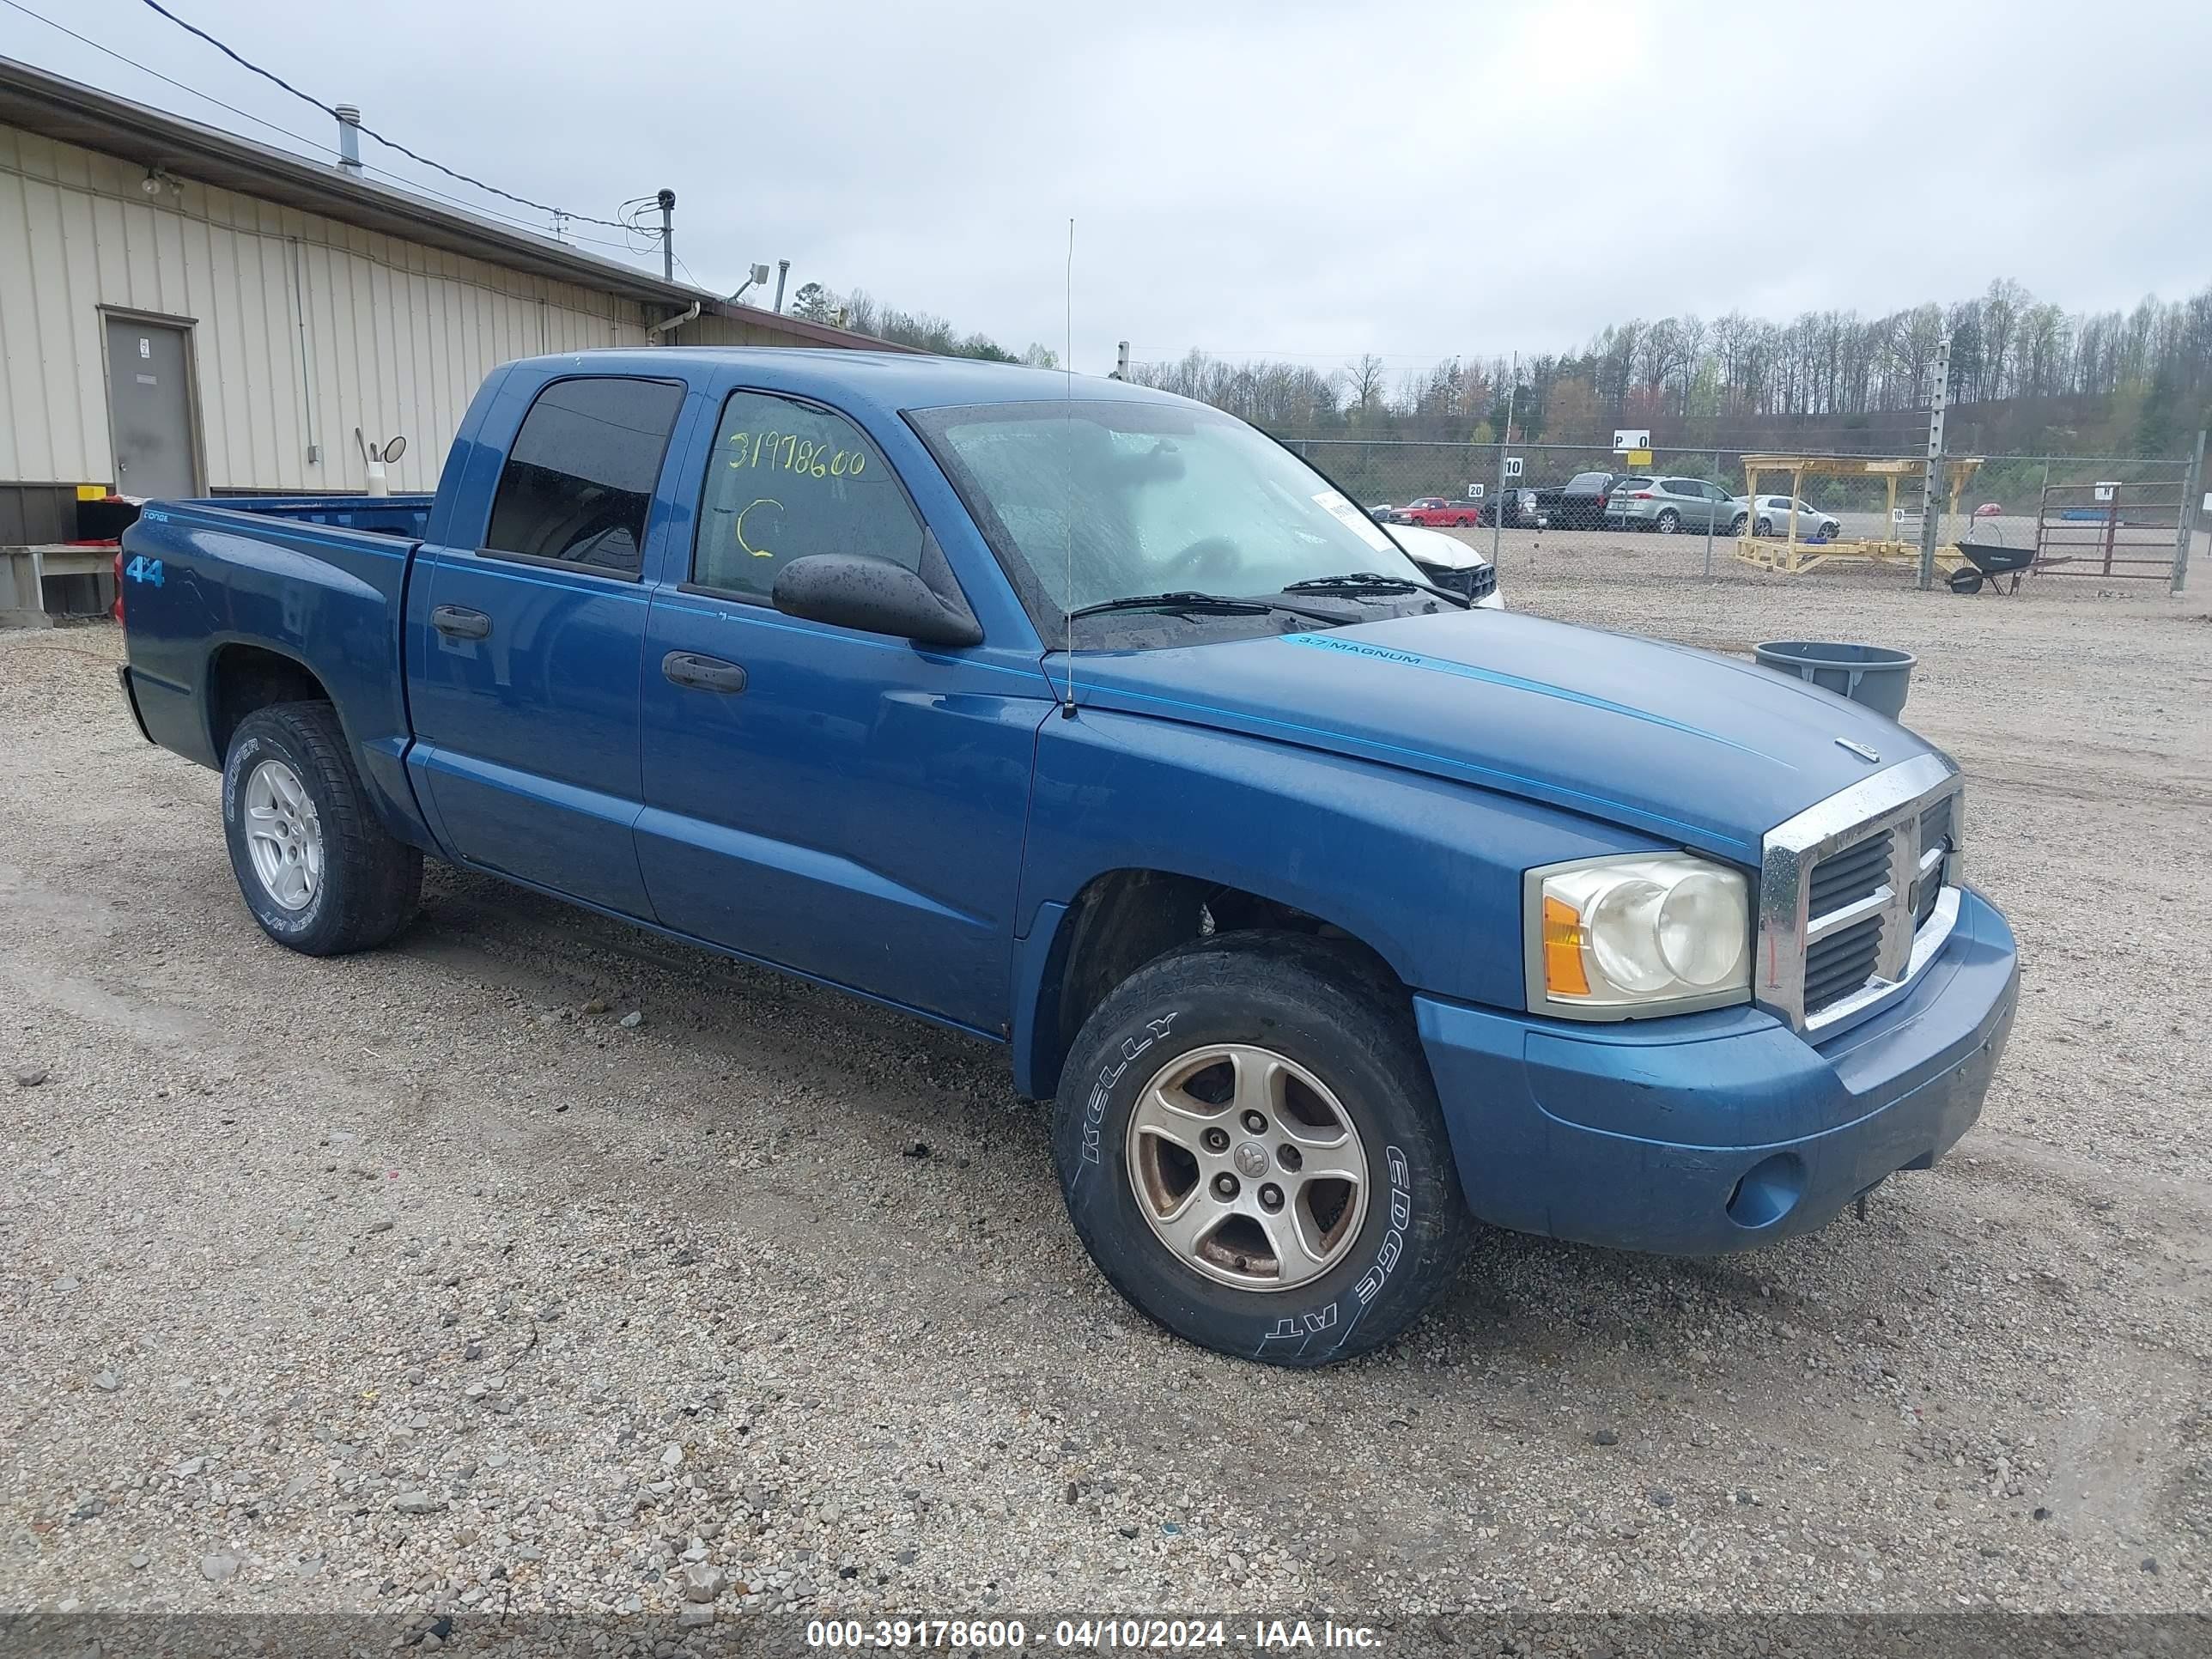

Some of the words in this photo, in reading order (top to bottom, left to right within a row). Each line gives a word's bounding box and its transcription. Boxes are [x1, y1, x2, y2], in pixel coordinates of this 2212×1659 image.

[1615, 435, 1623, 447] P
[1506, 460, 1520, 473] 10
[1470, 486, 1482, 496] 20
[737, 498, 784, 557] C
[1894, 510, 1903, 520] 10
[1298, 636, 1327, 646] 3.7
[1330, 641, 1422, 665] MAGNUM
[226, 738, 260, 823] COOPER
[1083, 1012, 1179, 1164] KELLY
[1355, 1146, 1411, 1305] EDGE
[1265, 1303, 1338, 1340] AT
